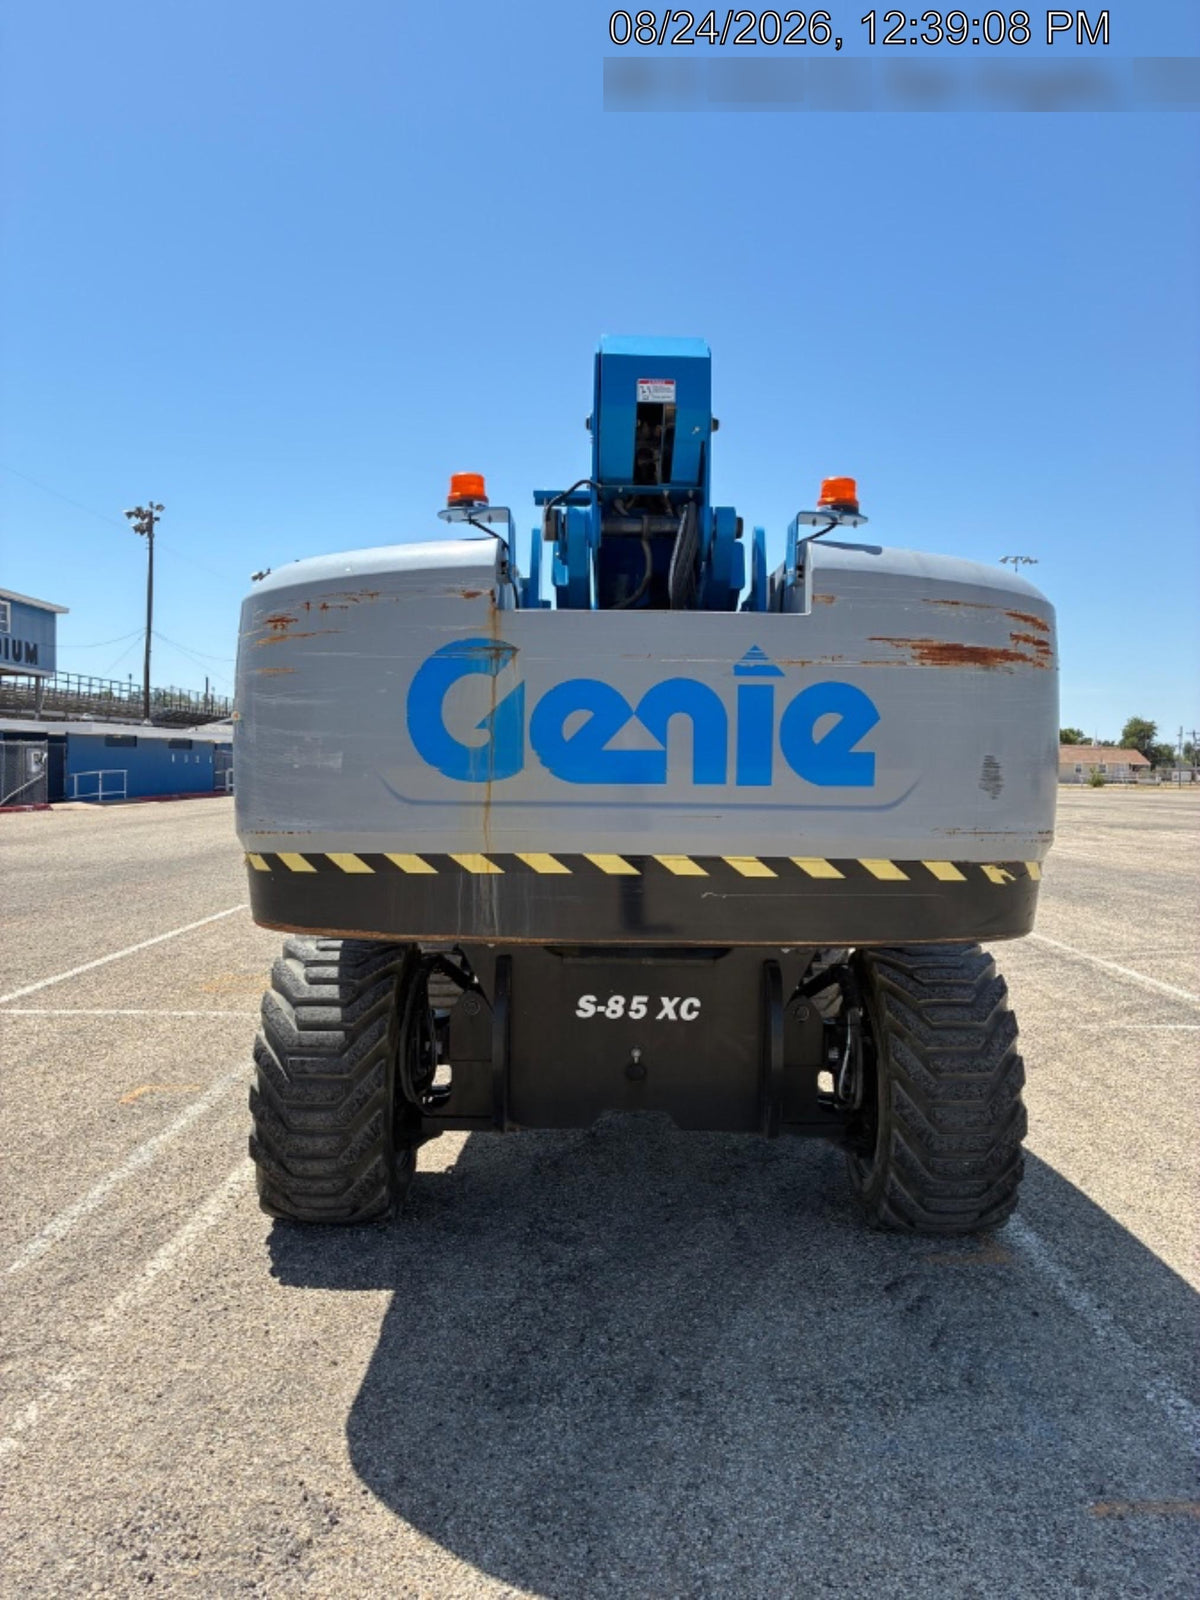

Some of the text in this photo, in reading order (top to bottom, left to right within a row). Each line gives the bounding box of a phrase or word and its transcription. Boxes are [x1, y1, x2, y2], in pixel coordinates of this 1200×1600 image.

[0, 636, 38, 665] IUM
[406, 637, 881, 787] Genie
[575, 994, 702, 1021] S-85 XC
